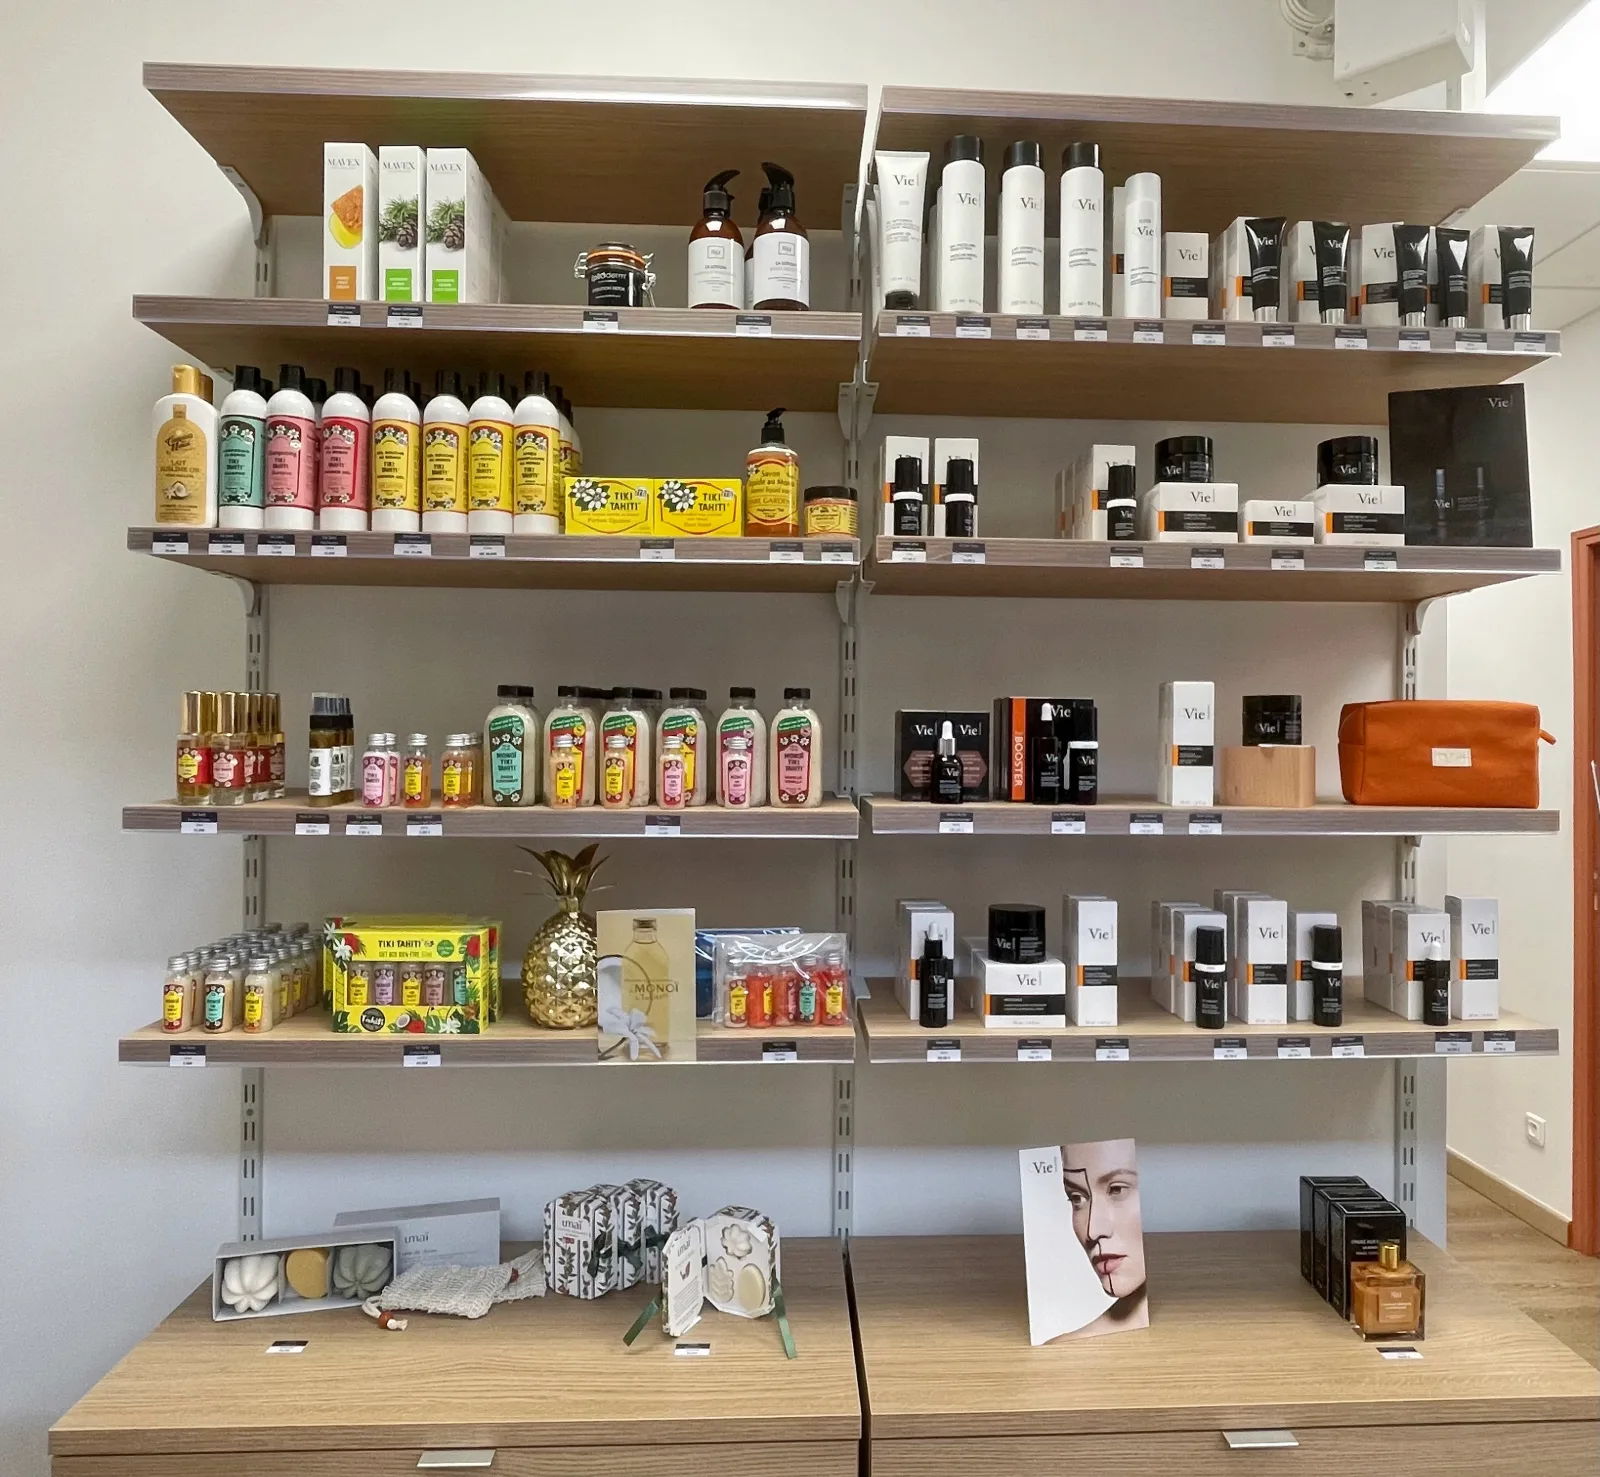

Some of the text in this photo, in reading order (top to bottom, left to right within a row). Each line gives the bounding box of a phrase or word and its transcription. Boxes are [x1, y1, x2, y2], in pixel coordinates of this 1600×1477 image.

[328, 158, 360, 167] MAVEX
[383, 161, 415, 170] MAVEX
[429, 163, 462, 172] MAVEX
[893, 174, 915, 186] Vie
[1137, 225, 1155, 237] Vie
[1257, 236, 1273, 246] Vie
[1327, 239, 1343, 249] Vie
[1178, 248, 1199, 261] Vie
[1373, 247, 1395, 259] Vie
[1487, 397, 1509, 408] Vie
[761, 470, 780, 478] Savon
[1165, 464, 1182, 475] Vie
[1340, 464, 1357, 475] Vie
[614, 491, 633, 501] TIKI
[702, 492, 721, 501] TIKI
[1190, 491, 1211, 504] Vie
[1357, 492, 1378, 505] Vie
[609, 502, 639, 511] TAHITI
[698, 503, 726, 512] TAHITI
[1434, 499, 1450, 509] Vie
[1273, 505, 1293, 517] Vie
[1050, 704, 1071, 717] Vie
[1184, 707, 1205, 720] Vie
[915, 724, 934, 736] Vie
[959, 724, 978, 736] Vie
[1258, 722, 1276, 733] Vie
[1014, 736, 1024, 787] BOOSTER
[1088, 927, 1109, 940] Vie
[1259, 926, 1279, 939] Vie
[1471, 923, 1491, 935] Vie
[378, 939, 421, 948] TIKI TAHITI
[996, 937, 1011, 950] Vie
[1016, 973, 1038, 986] Vie
[1203, 979, 1219, 989] Vie
[634, 980, 680, 993] MONOÏ
[362, 1014, 384, 1026] Tahiti
[1032, 1161, 1053, 1174] Vie
